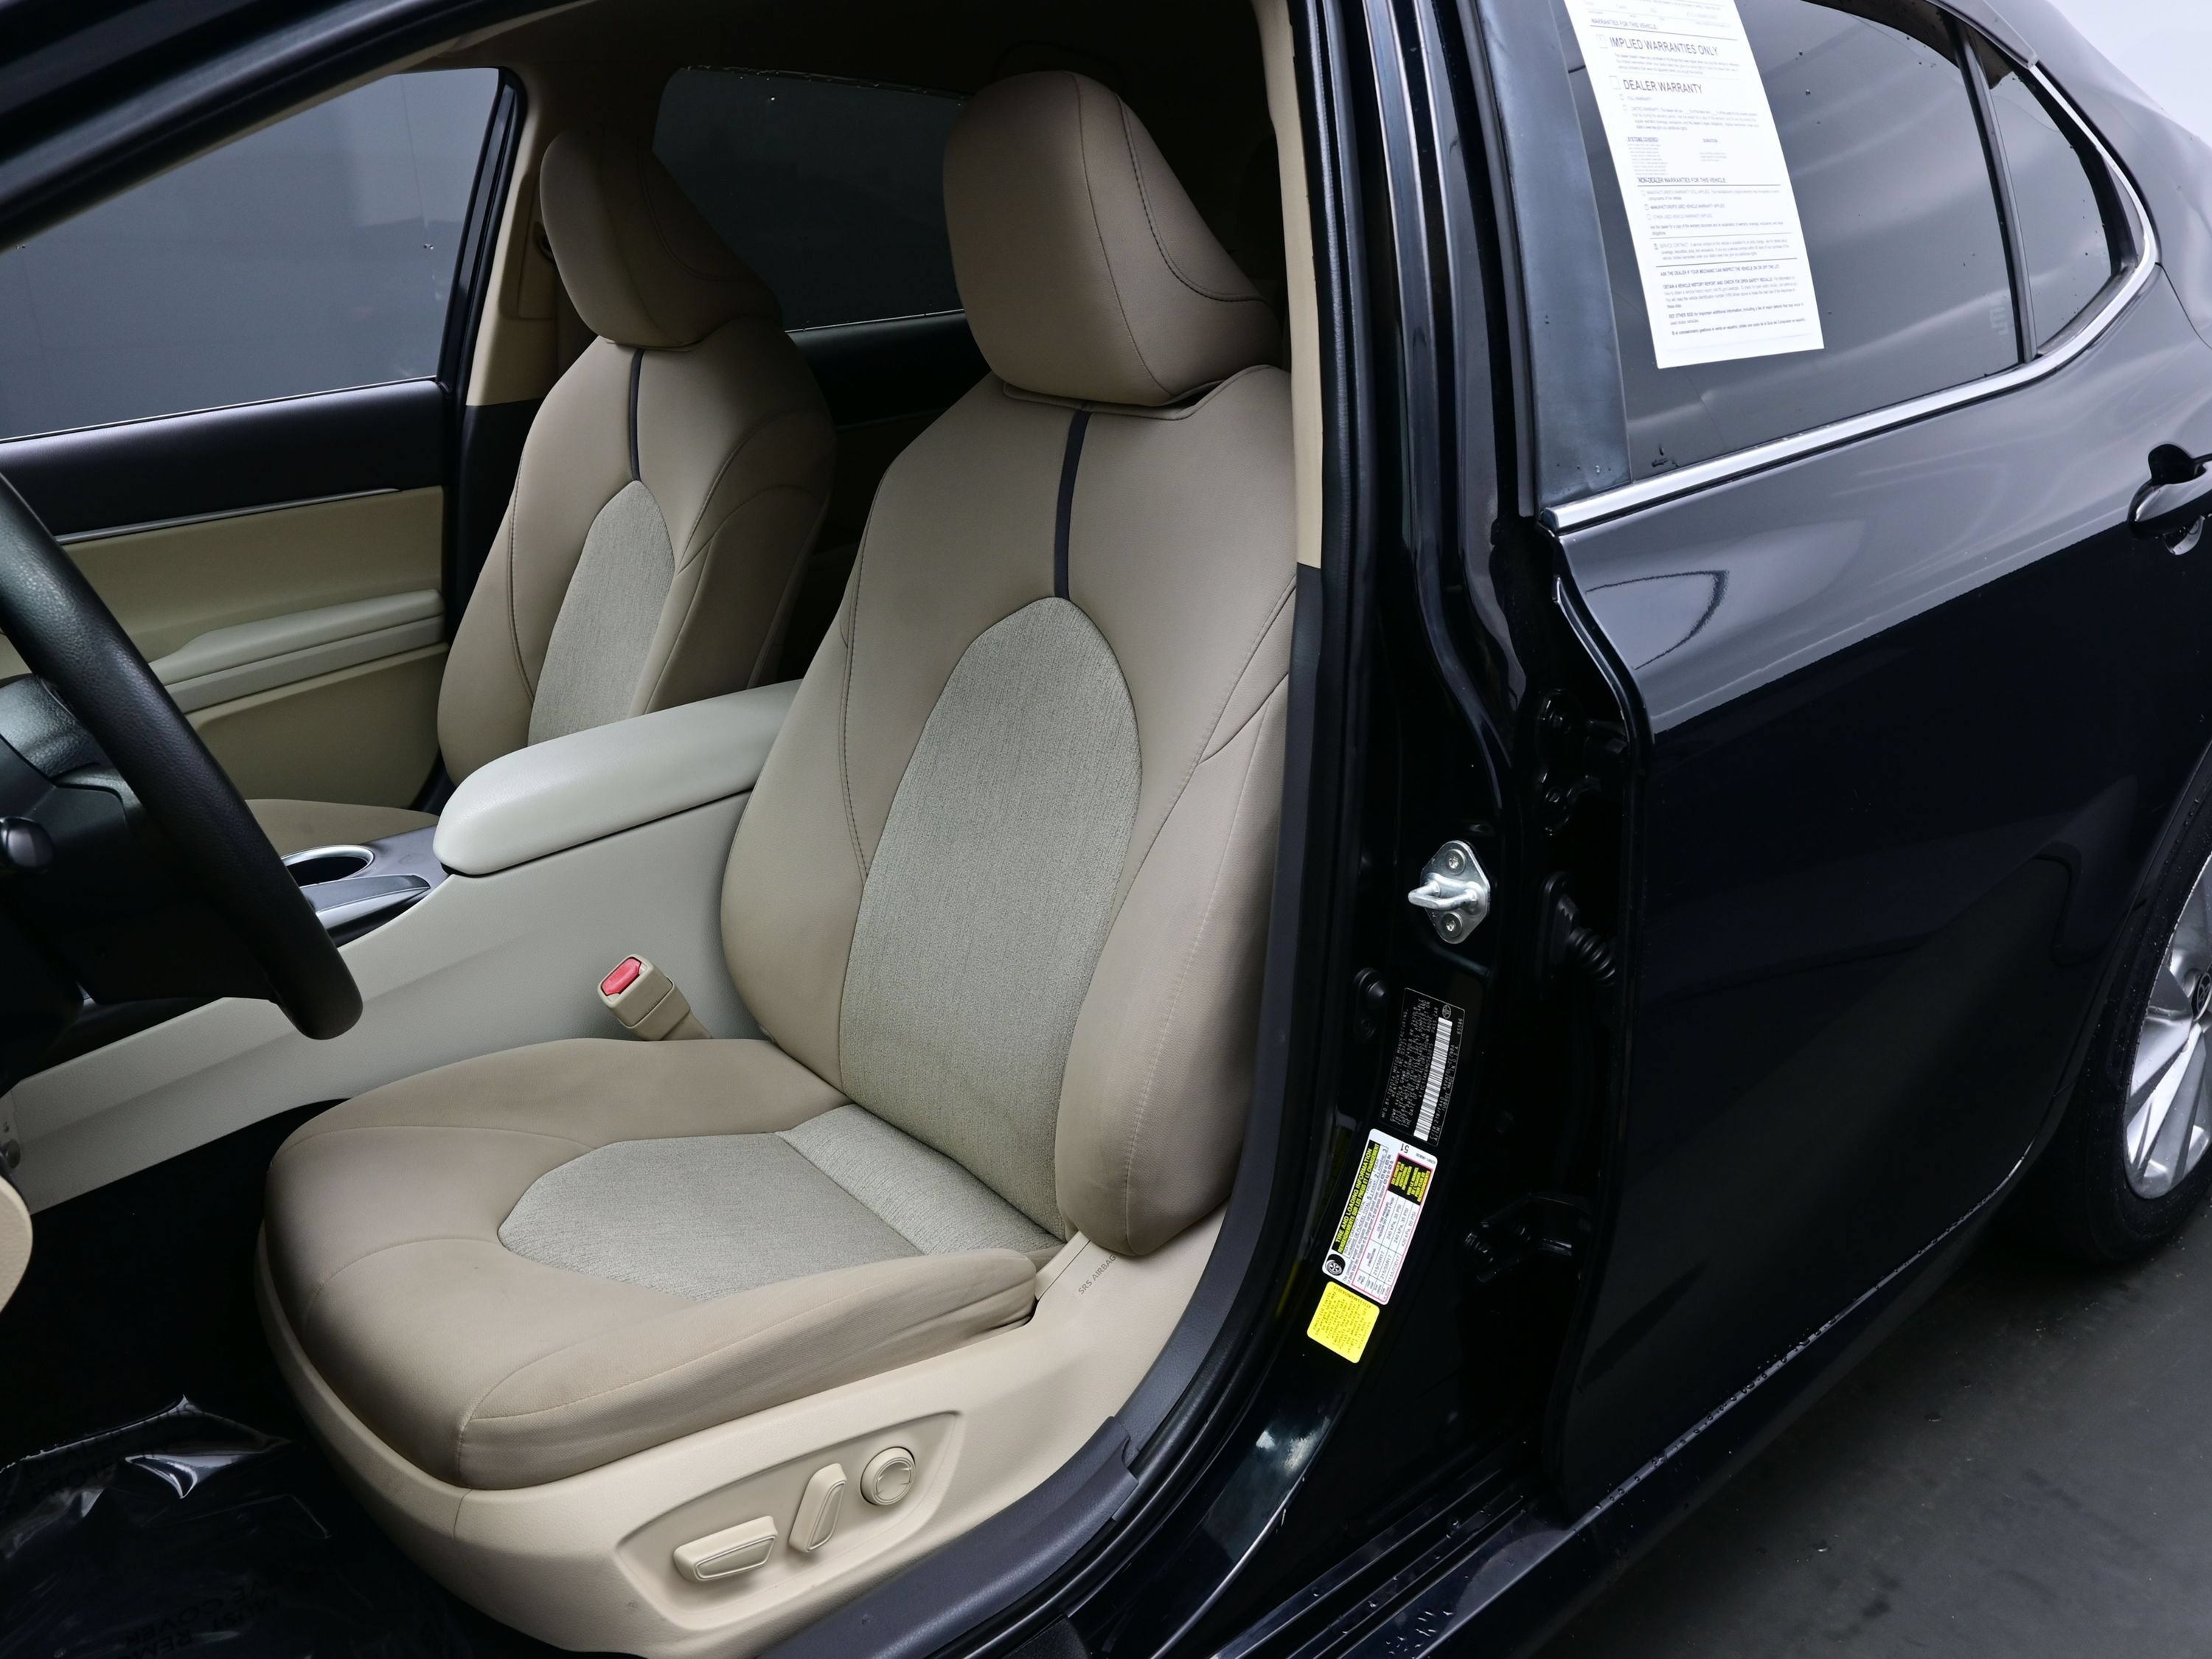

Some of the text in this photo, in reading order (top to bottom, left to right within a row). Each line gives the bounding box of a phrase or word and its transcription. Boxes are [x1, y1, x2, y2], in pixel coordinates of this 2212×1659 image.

[1610, 37, 1719, 56] IMPLIED WARRANTIES ONLY
[1623, 80, 1703, 94] DEALER WARRANTY
[1401, 1143, 1410, 1153] 51
[1335, 1229, 1344, 1243] TIRE
[1346, 1189, 1359, 1216] LOADING
[1355, 1148, 1372, 1189] INFORMATION
[1338, 1215, 1355, 1253] RENSEIGNEMENTS
[1357, 1184, 1366, 1198] PNEUS
[1367, 1143, 1380, 1172] CHARGEMENT
[1078, 1255, 1116, 1295] SRS AIRBAG
[1373, 1251, 1385, 1276] 215/55R17
[1380, 1254, 1392, 1279] 215/55R17
